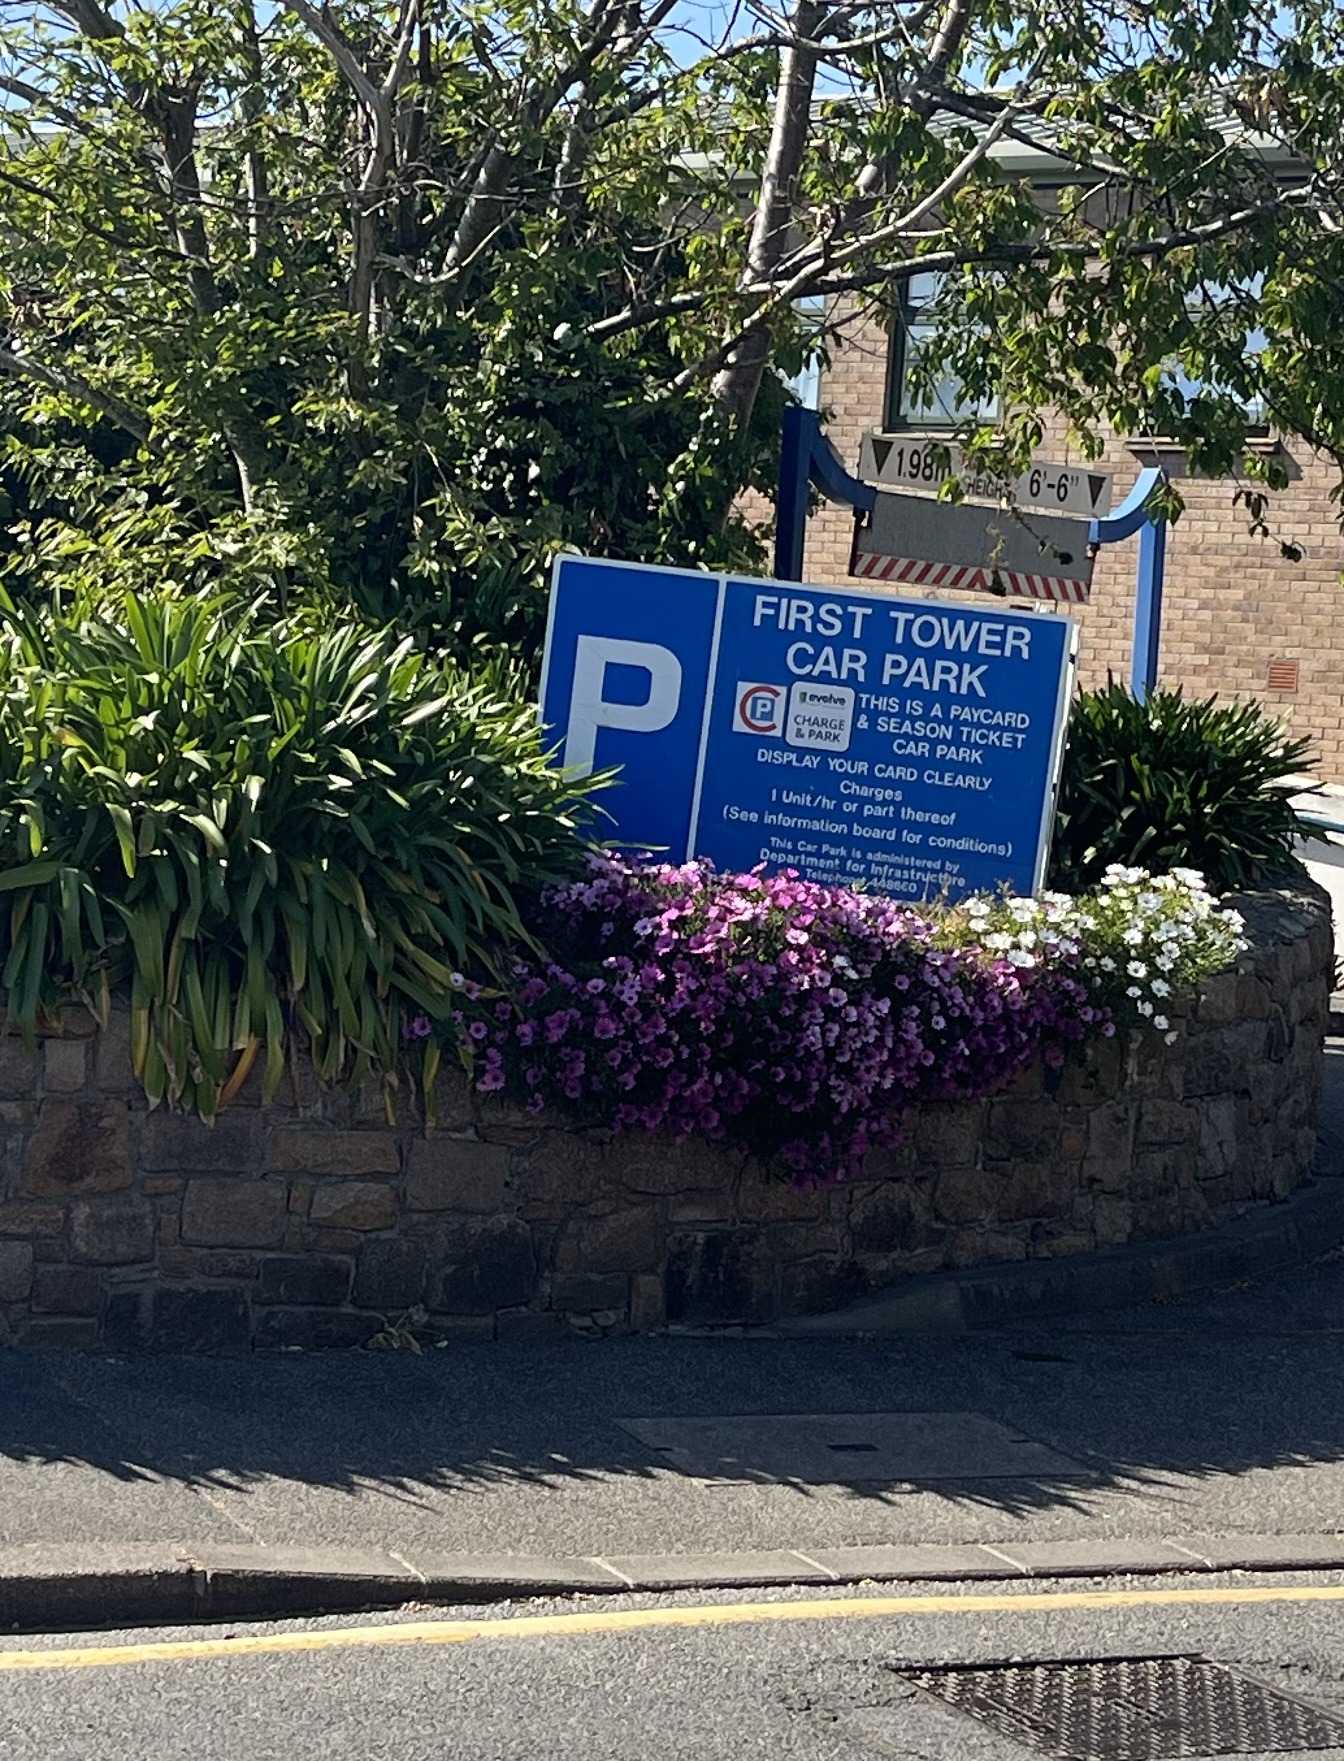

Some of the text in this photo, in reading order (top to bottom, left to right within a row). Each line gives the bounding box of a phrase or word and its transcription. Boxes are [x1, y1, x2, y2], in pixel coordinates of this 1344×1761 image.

[966, 478, 1010, 501] HEIGH
[753, 594, 1032, 660] FIRST TOWER
[786, 641, 989, 698] CAR PARK
[563, 634, 682, 784] P
[808, 692, 846, 706] evolve
[858, 693, 1031, 729] THIS IS A PAYCARD
[793, 714, 846, 731] CHARGE
[795, 727, 841, 743] & PARK
[856, 713, 1027, 750] & SEASON TICKET
[757, 748, 993, 791] DISPLAY YOUR CARD CLEARLY
[892, 738, 984, 765] CAR PARK
[771, 788, 957, 826] 1 Unit/hr or part thereof
[839, 780, 903, 802] Charges
[722, 804, 1013, 858] (See information board for conditions)
[759, 847, 966, 888] Department for Infrastructure
[770, 836, 960, 874] This Car Park is administered by
[805, 868, 861, 886] Telephon
